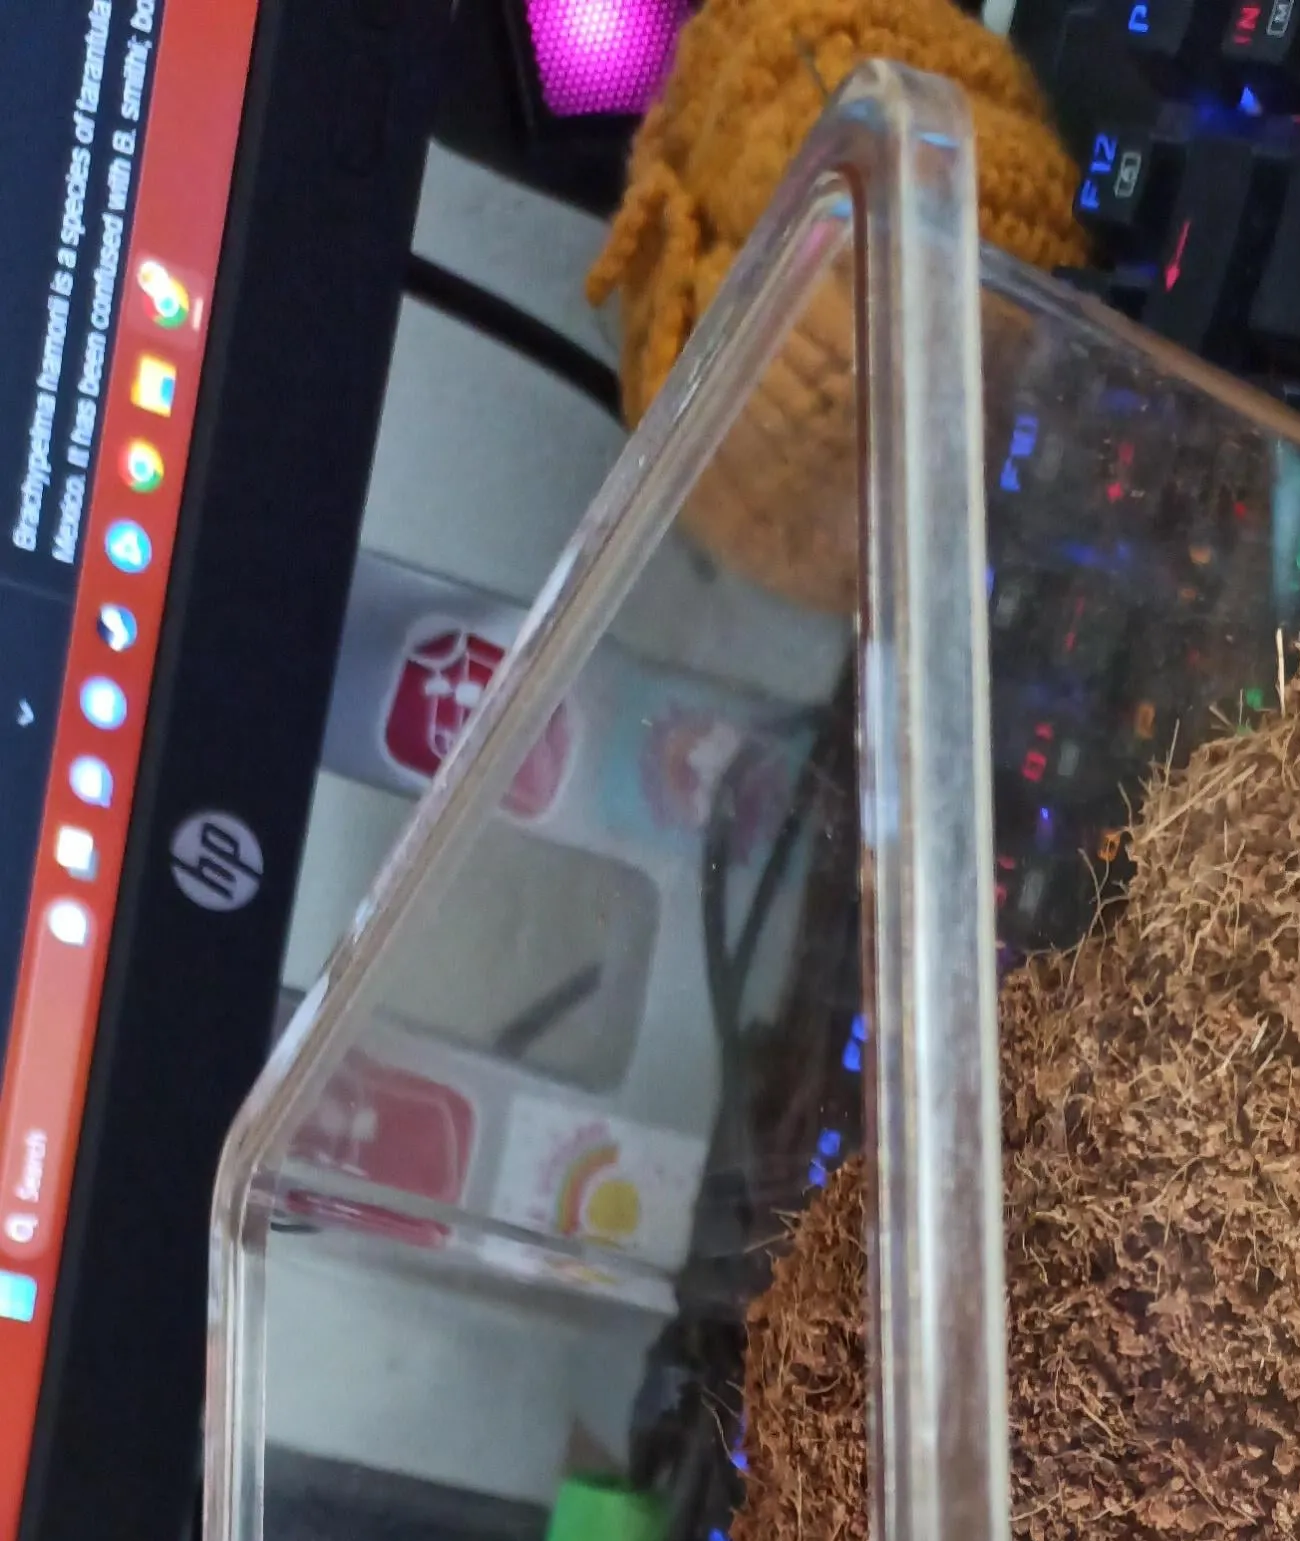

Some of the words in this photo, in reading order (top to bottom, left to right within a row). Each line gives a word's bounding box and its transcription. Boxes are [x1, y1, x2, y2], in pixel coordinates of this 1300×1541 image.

[74, 111, 95, 144] of
[112, 128, 136, 155] B.
[60, 146, 91, 246] species
[106, 157, 132, 210] with
[1080, 132, 1117, 211] F12
[50, 271, 74, 297] is
[56, 247, 77, 268] a
[89, 212, 124, 330] confused
[77, 332, 107, 396] been
[70, 398, 97, 447] has
[12, 392, 56, 552] Brachypelma
[67, 448, 90, 468] It
[52, 474, 87, 564] Mexico.
[170, 822, 264, 901] hp
[18, 1130, 49, 1202] Search
